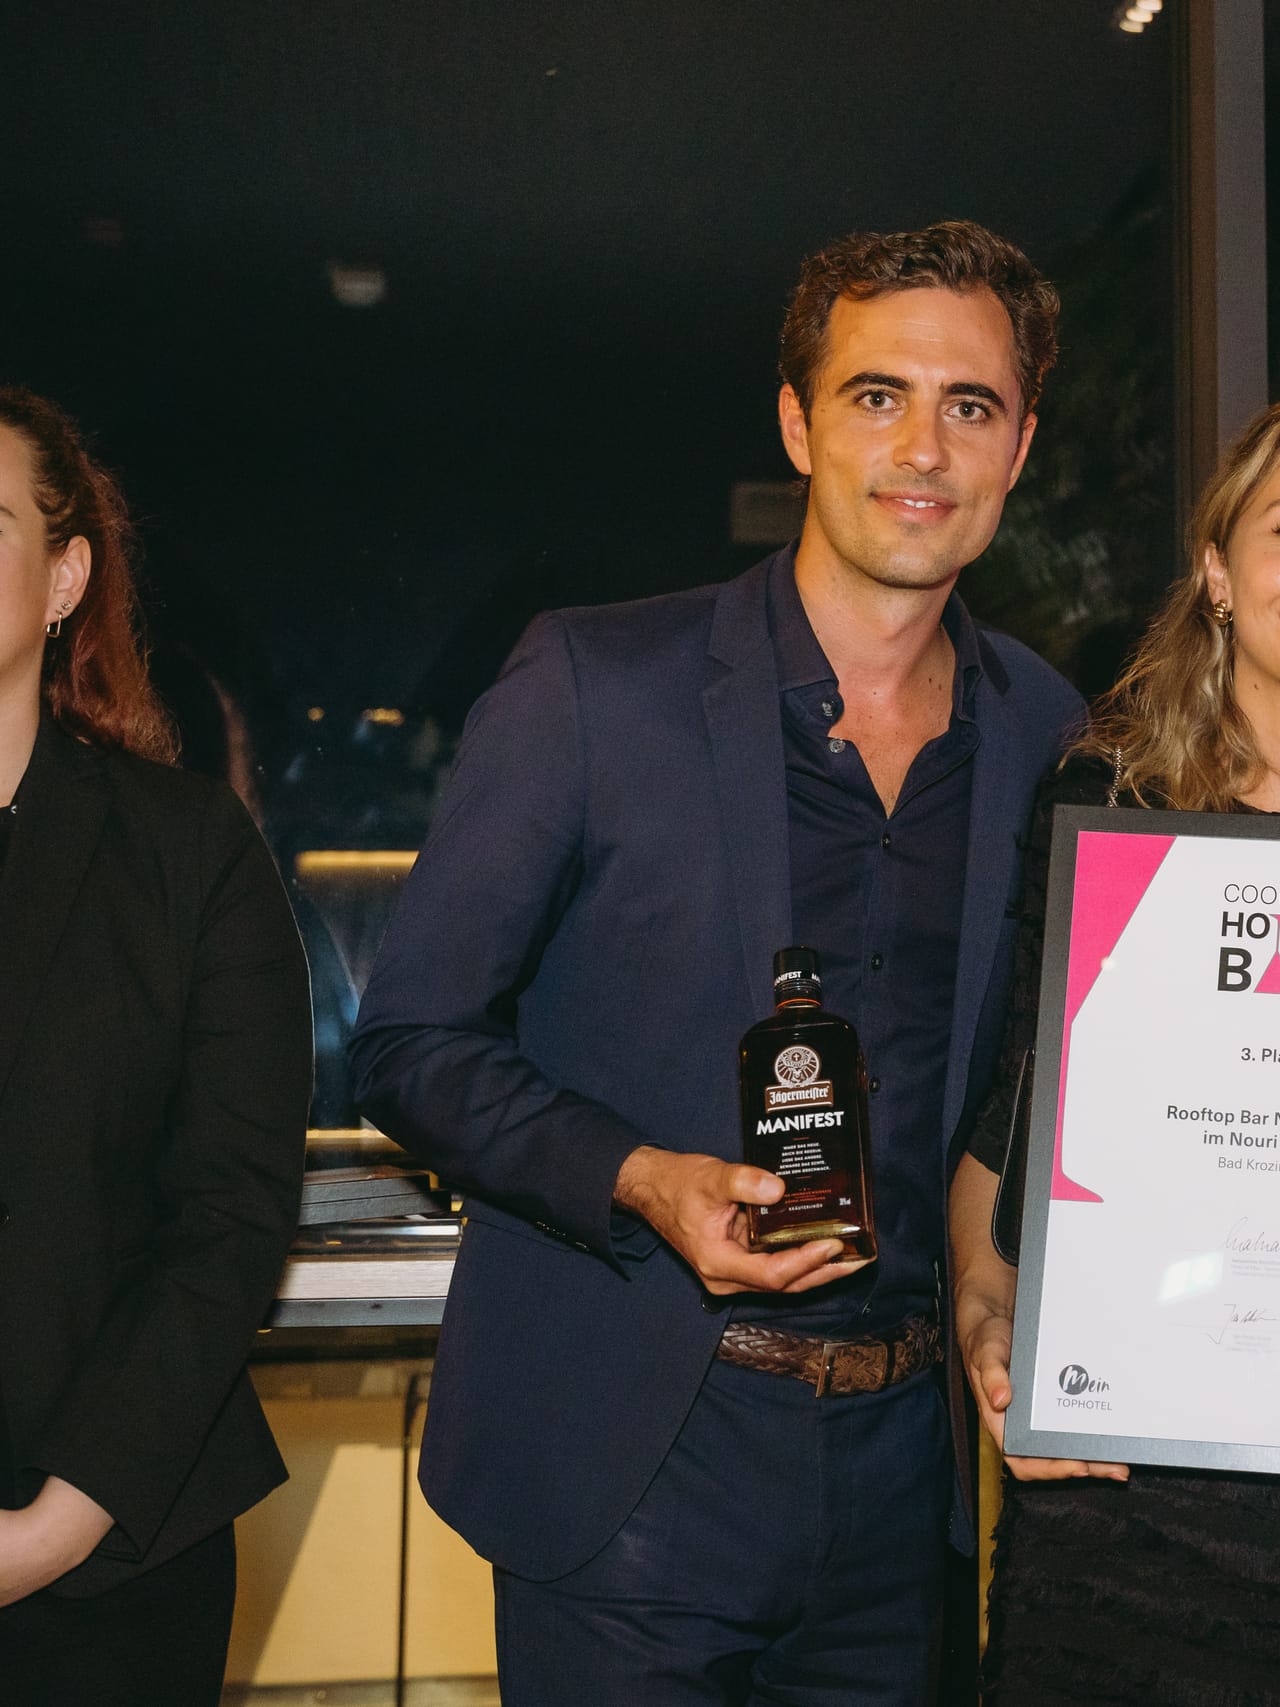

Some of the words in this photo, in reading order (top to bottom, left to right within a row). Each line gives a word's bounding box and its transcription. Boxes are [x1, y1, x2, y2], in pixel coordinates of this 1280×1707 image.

[1241, 1047, 1256, 1062] 3.
[757, 1111, 844, 1135] MANIFEST
[1167, 1105, 1235, 1126] Rooftop
[1240, 1110, 1270, 1126] Bar
[1203, 1130, 1224, 1145] im
[1230, 1132, 1278, 1149] Nouri
[1218, 1157, 1242, 1170] Bad
[1059, 1364, 1111, 1395] Mein
[1056, 1398, 1113, 1411] TOPHOTEL
